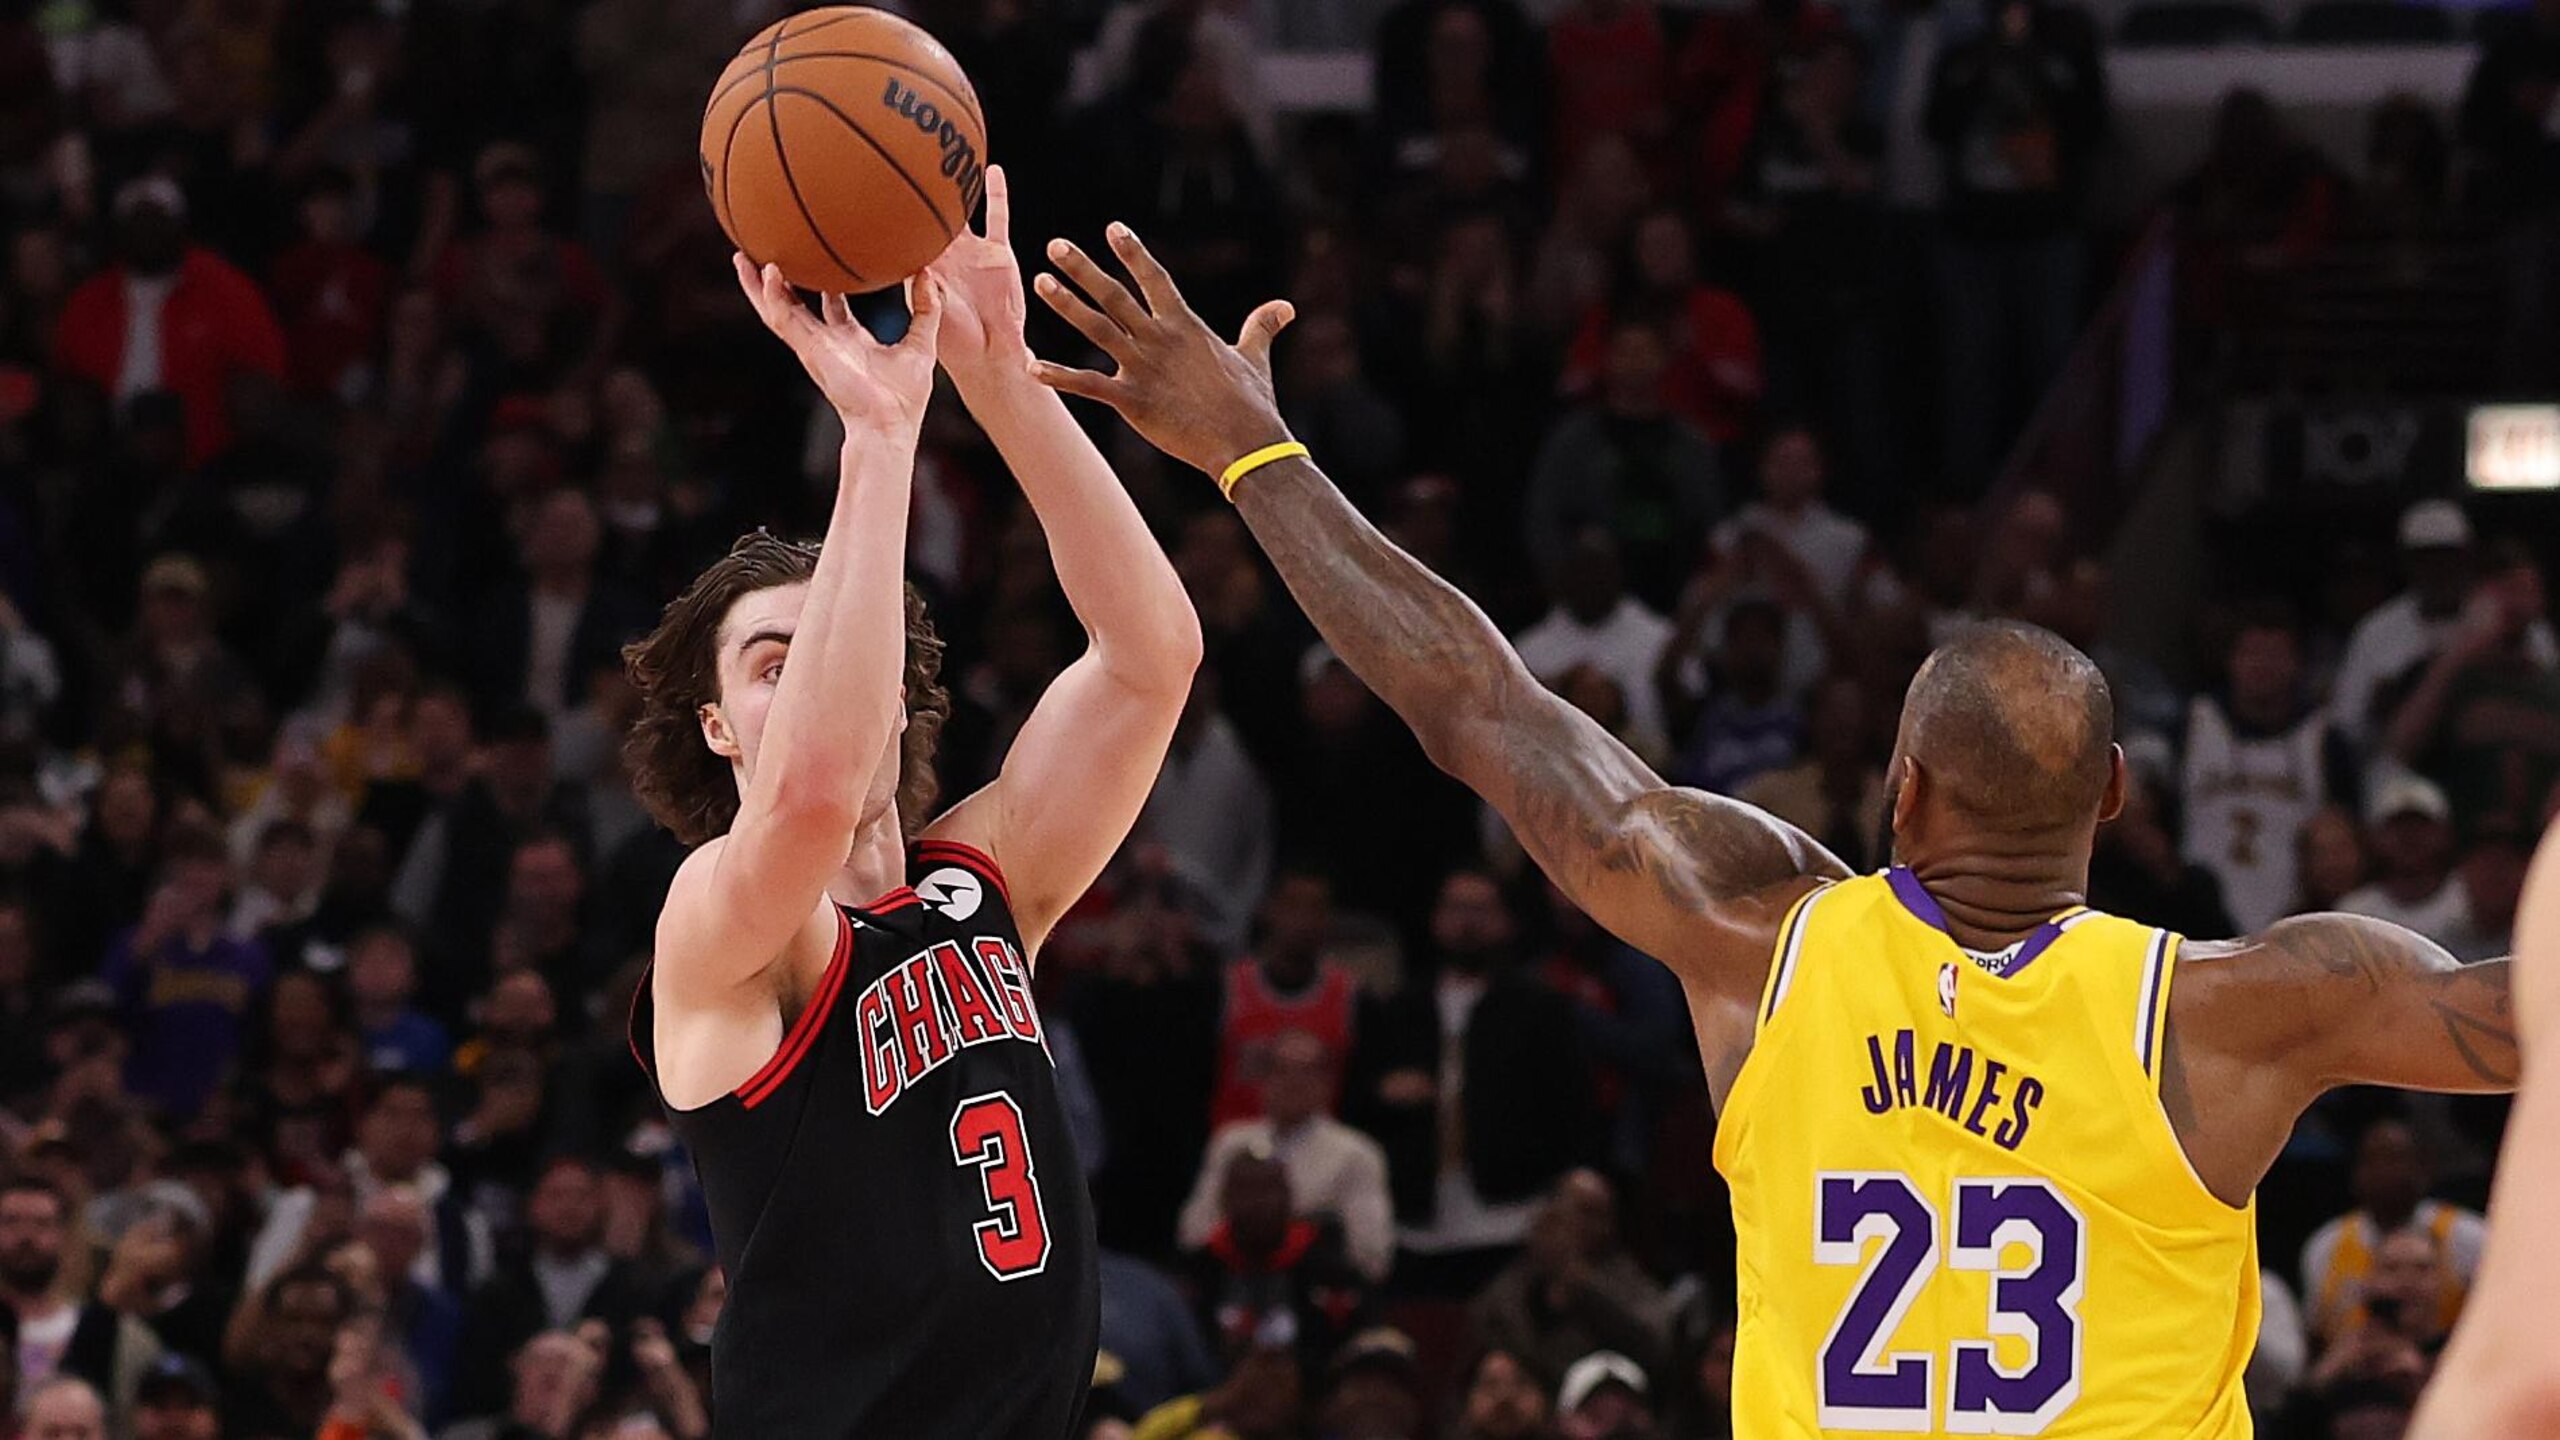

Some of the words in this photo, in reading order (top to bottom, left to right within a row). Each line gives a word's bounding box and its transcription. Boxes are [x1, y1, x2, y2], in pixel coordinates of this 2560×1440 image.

[1861, 1029, 2044, 1151] JAMES
[949, 1091, 1052, 1281] 3
[1814, 1172, 2086, 1434] 23
